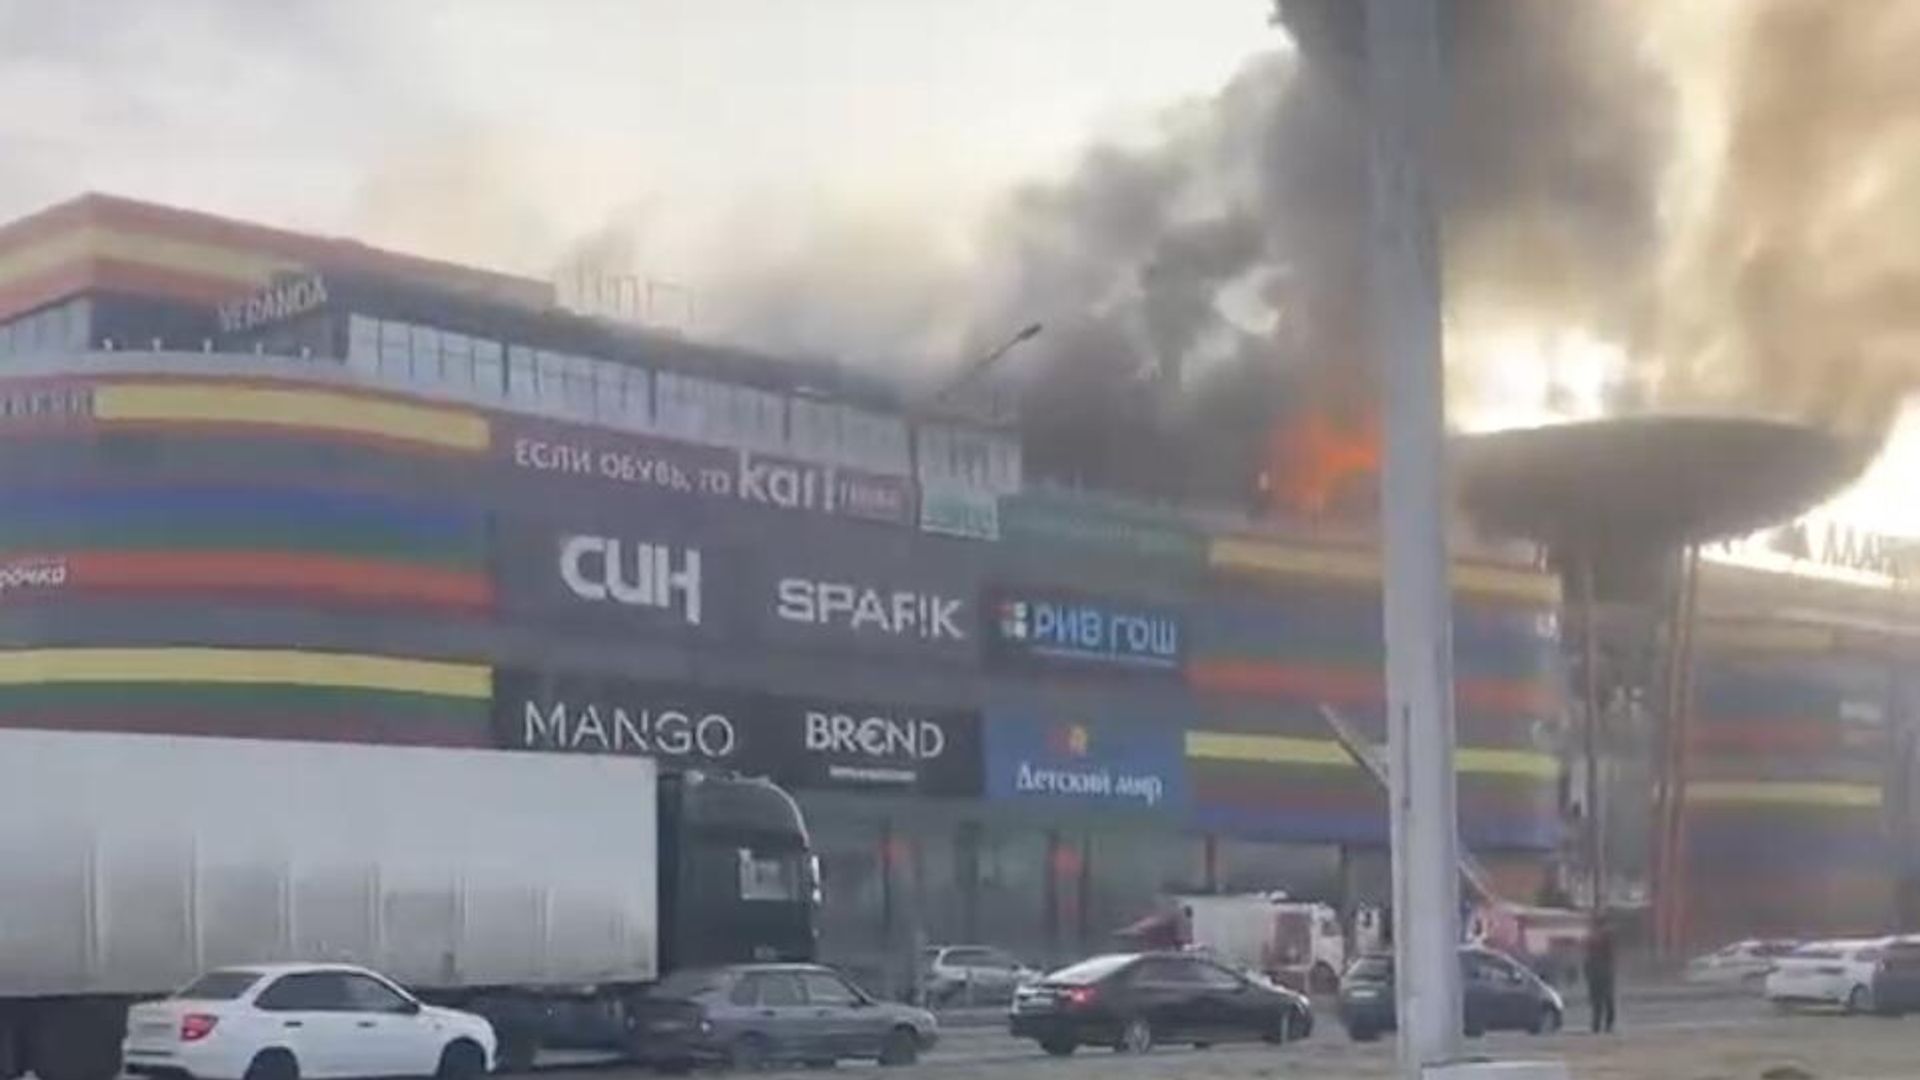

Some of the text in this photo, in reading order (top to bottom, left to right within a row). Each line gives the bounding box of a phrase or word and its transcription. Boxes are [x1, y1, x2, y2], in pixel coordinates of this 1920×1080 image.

[514, 438, 592, 474] ЕСЛИ
[523, 699, 736, 757] MANGO
[1016, 761, 1110, 796] Детский
